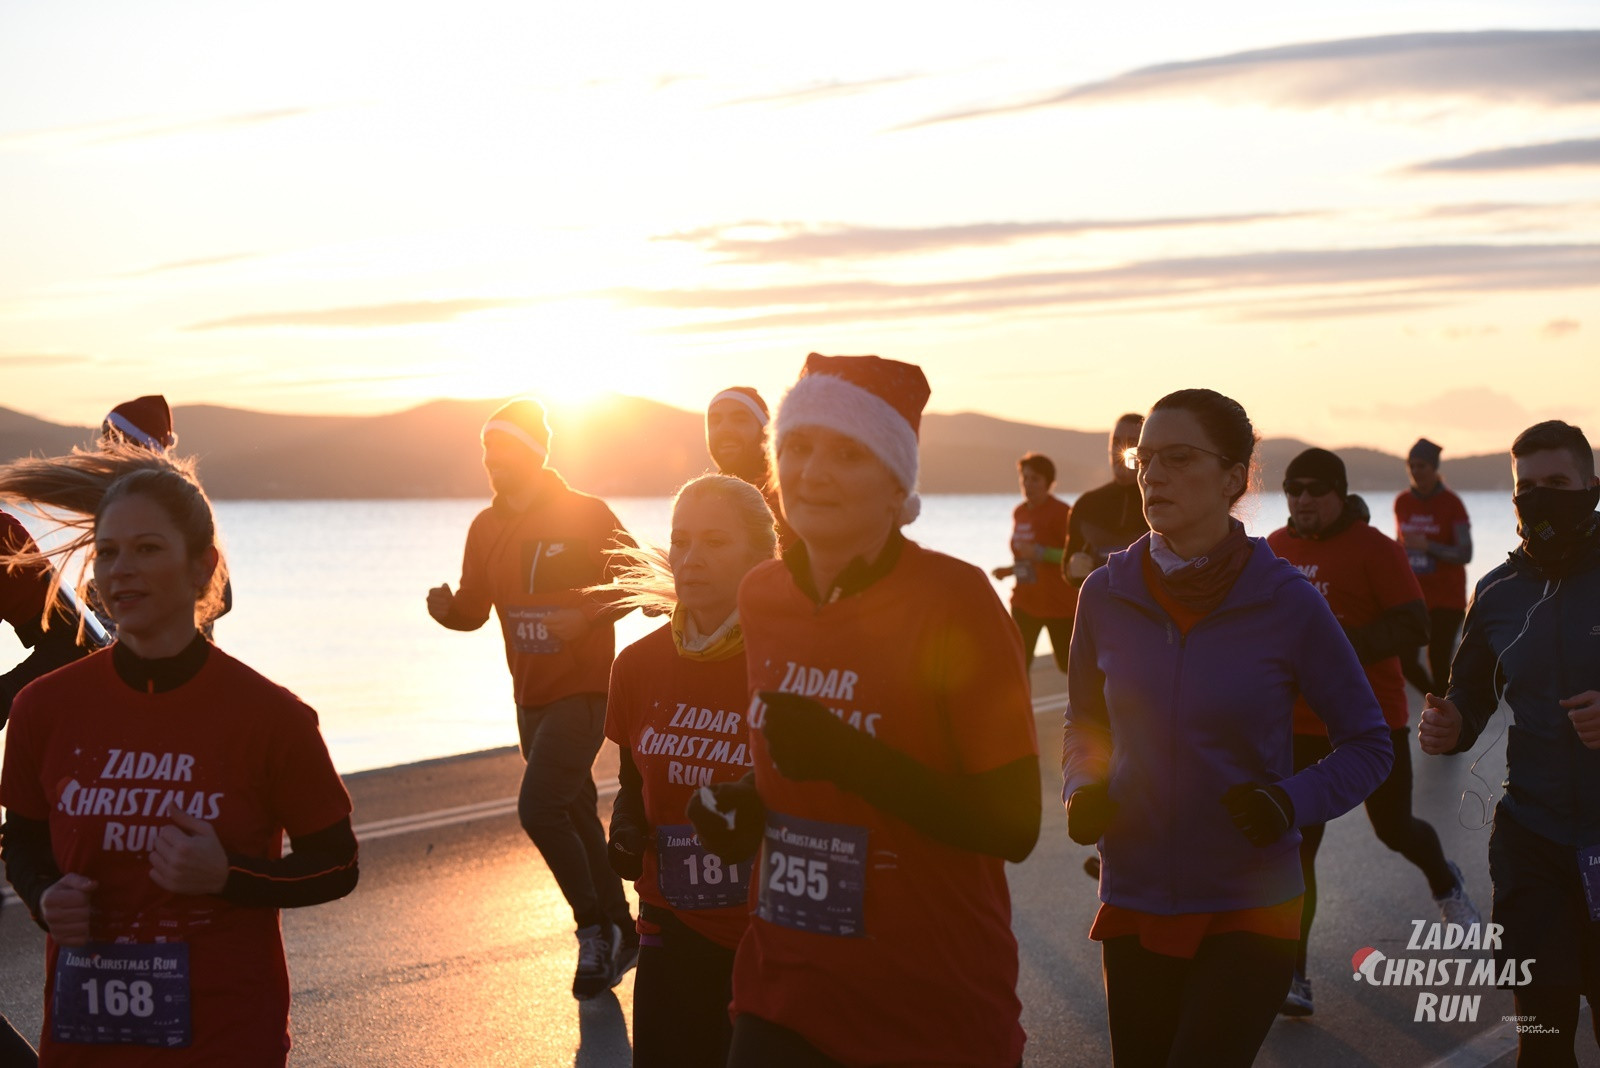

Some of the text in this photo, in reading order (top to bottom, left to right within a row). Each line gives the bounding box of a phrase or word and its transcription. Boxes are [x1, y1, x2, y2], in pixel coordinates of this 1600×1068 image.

[517, 622, 548, 640] 418
[778, 661, 858, 701] ZADAR
[669, 703, 741, 735] ZADAR
[100, 749, 195, 782] ZADAR
[668, 761, 714, 787] RUN
[61, 779, 224, 820] CHRISTMAS
[667, 836, 691, 847] ZADAR
[831, 838, 855, 854] RUN
[769, 851, 829, 901] 255
[66, 953, 177, 970] ZADAR CHRISTMAS RUN
[81, 978, 154, 1017] 168
